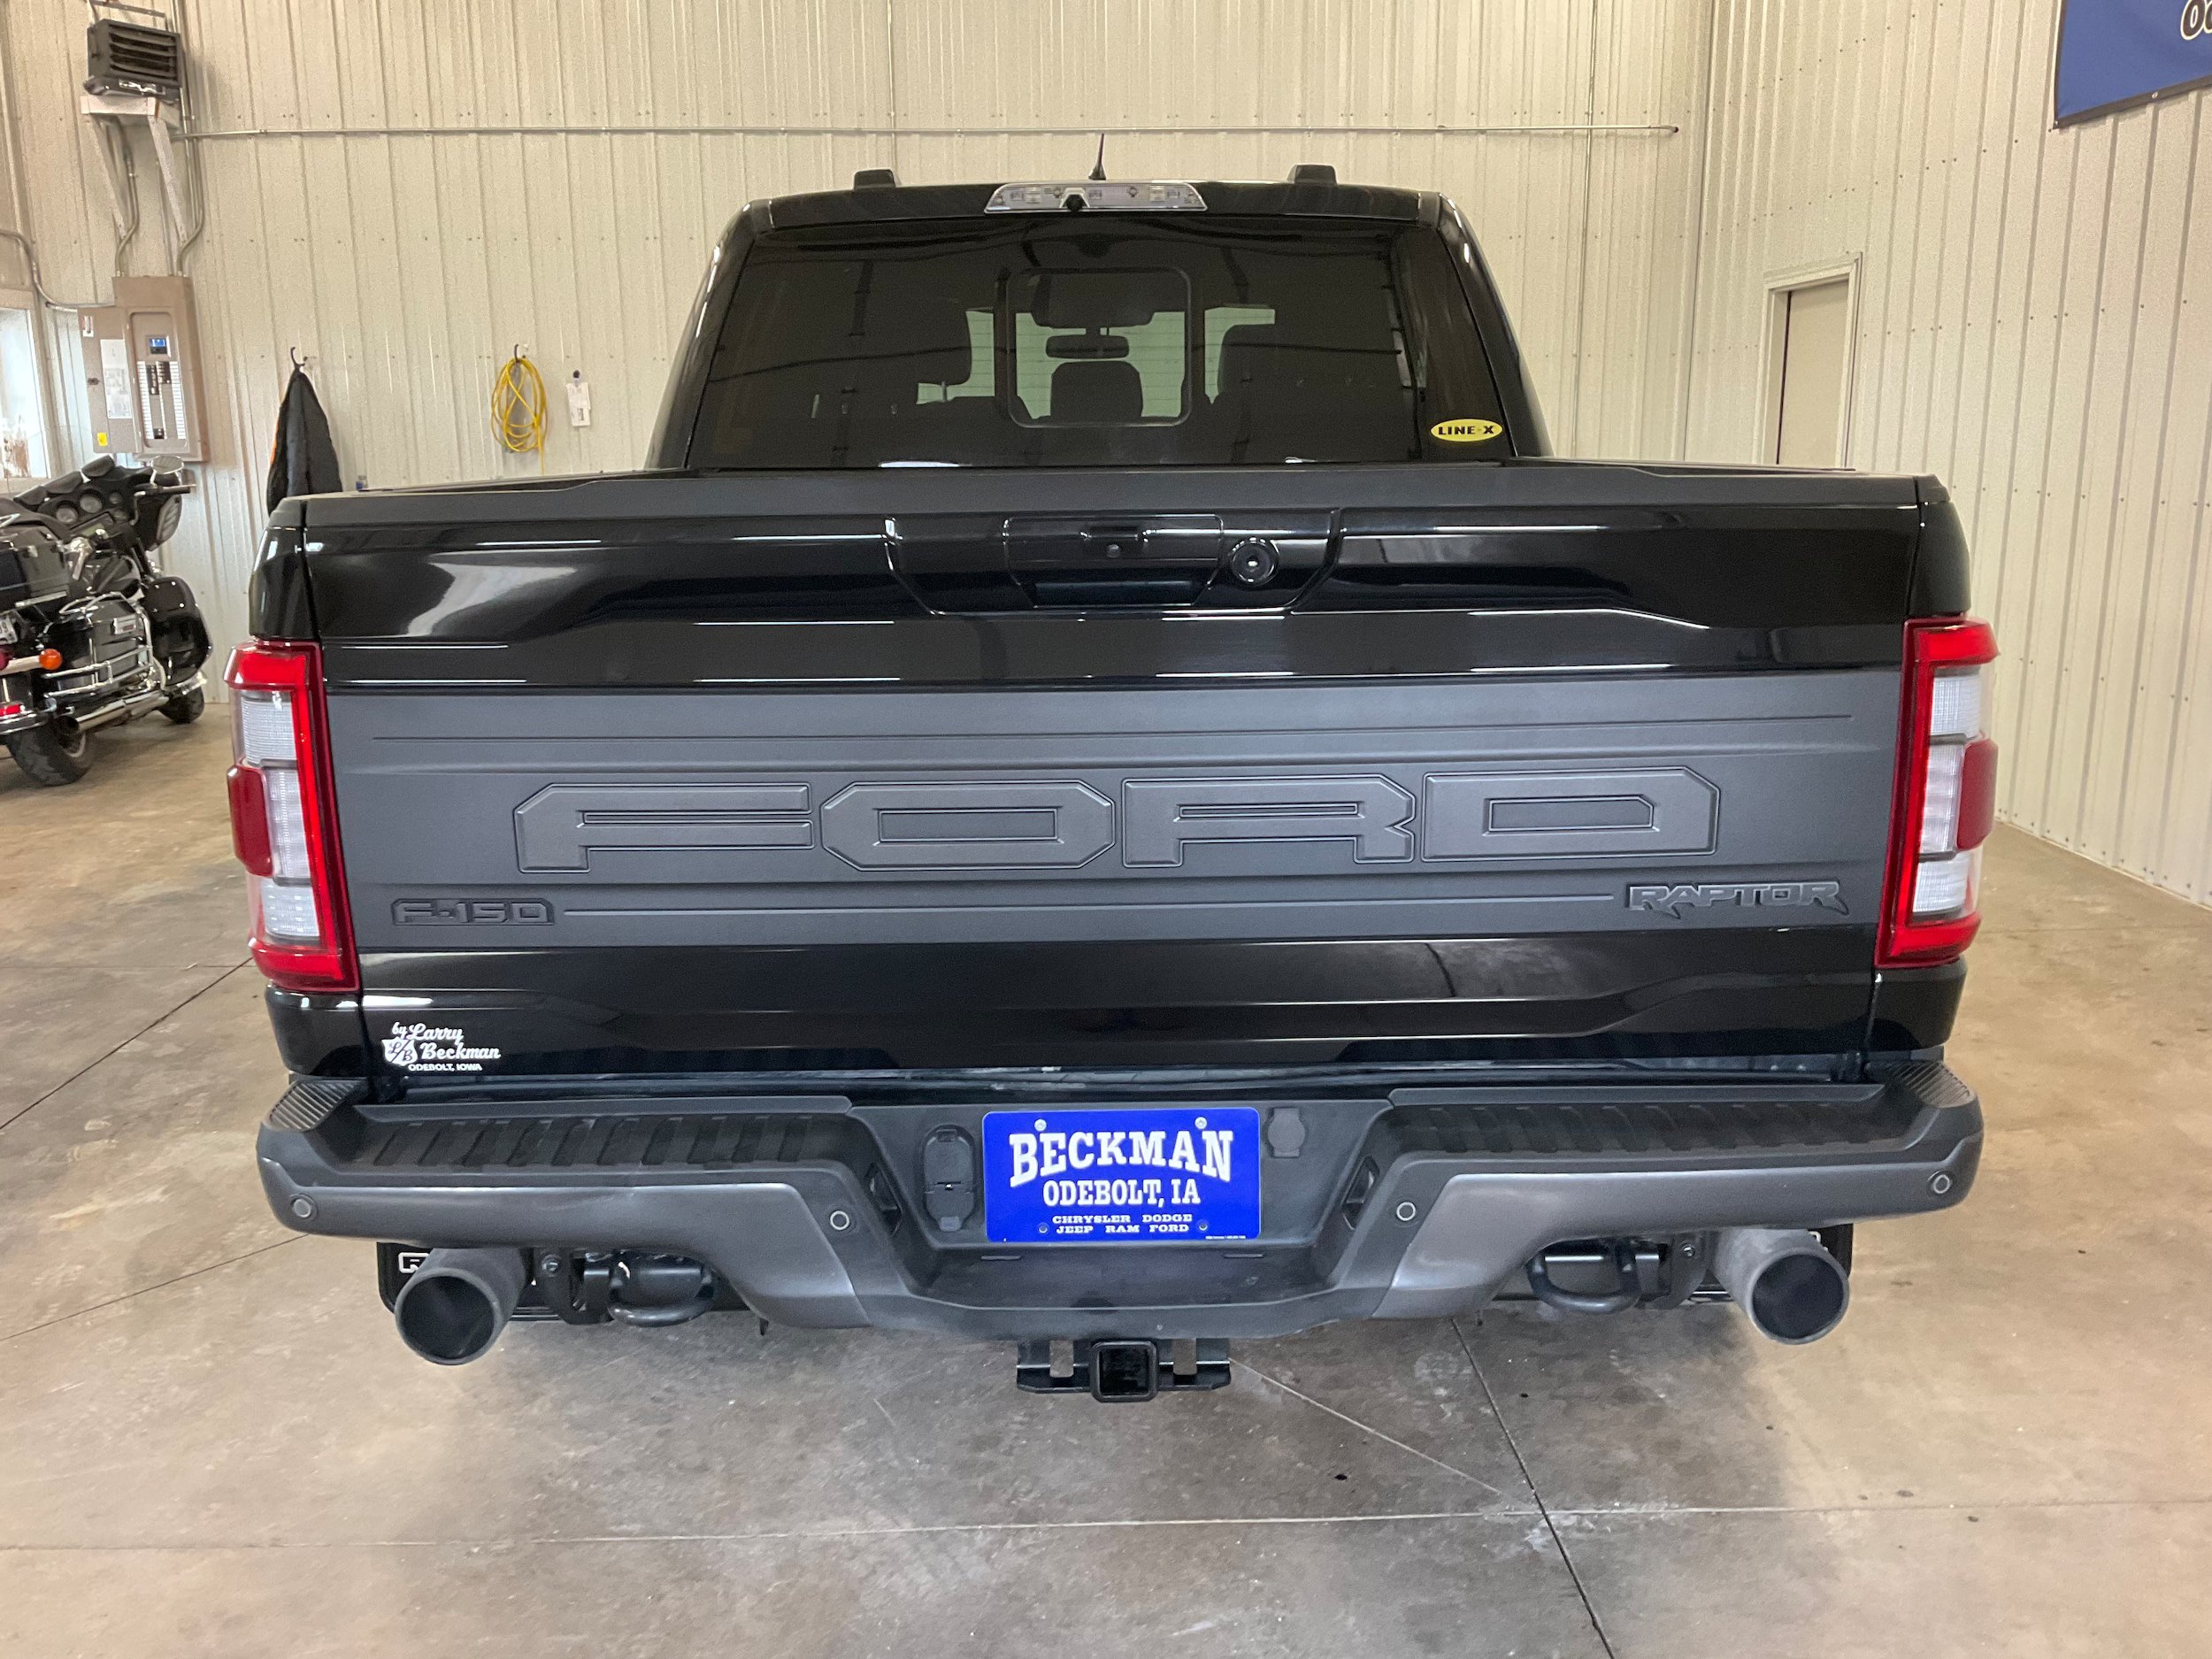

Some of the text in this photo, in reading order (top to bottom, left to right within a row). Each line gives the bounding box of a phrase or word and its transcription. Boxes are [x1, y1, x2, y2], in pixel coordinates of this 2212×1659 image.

[512, 766, 1719, 872] FORD
[392, 898, 555, 926] F-150
[1627, 879, 1849, 919] RAPTOR
[392, 1021, 464, 1045] by Larry
[419, 1042, 501, 1059] Beckman
[1009, 1130, 1233, 1187] BECKMAN
[1042, 1179, 1201, 1208] ODEBOLT, IA
[1052, 1214, 1193, 1224] CHRYSLER DODGE
